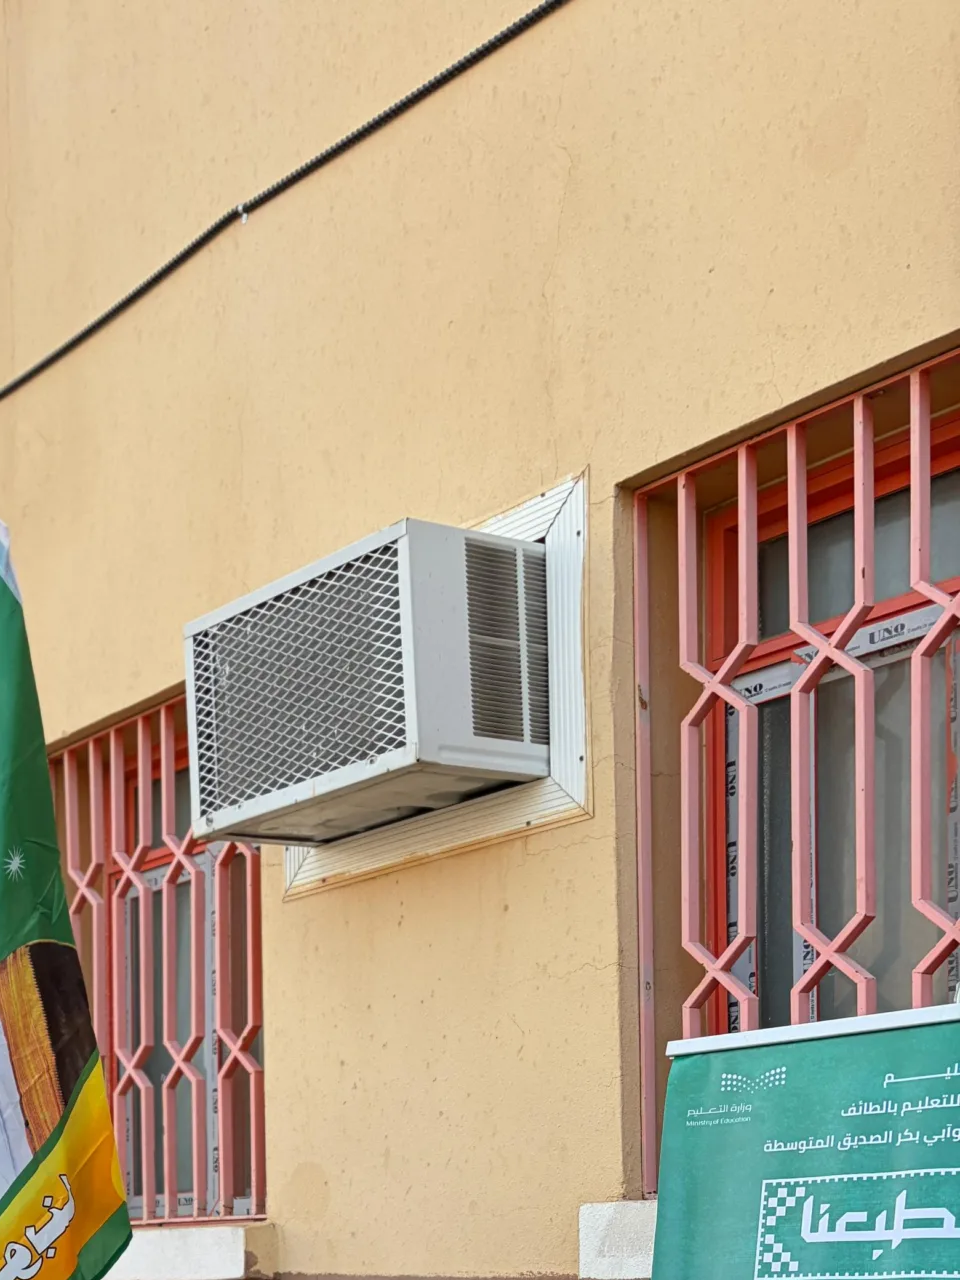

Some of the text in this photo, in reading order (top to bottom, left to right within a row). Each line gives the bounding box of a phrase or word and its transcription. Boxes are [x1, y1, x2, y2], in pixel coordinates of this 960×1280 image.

[868, 623, 906, 645] UNO
[726, 760, 737, 797] UNO
[727, 841, 737, 877] UNO
[687, 1103, 752, 1117] وزارة التعليم
[841, 1100, 898, 1117] بالطائف
[763, 1135, 835, 1153] المتوسطة
[837, 1130, 893, 1150] الصديق
[896, 1129, 920, 1146] بكر
